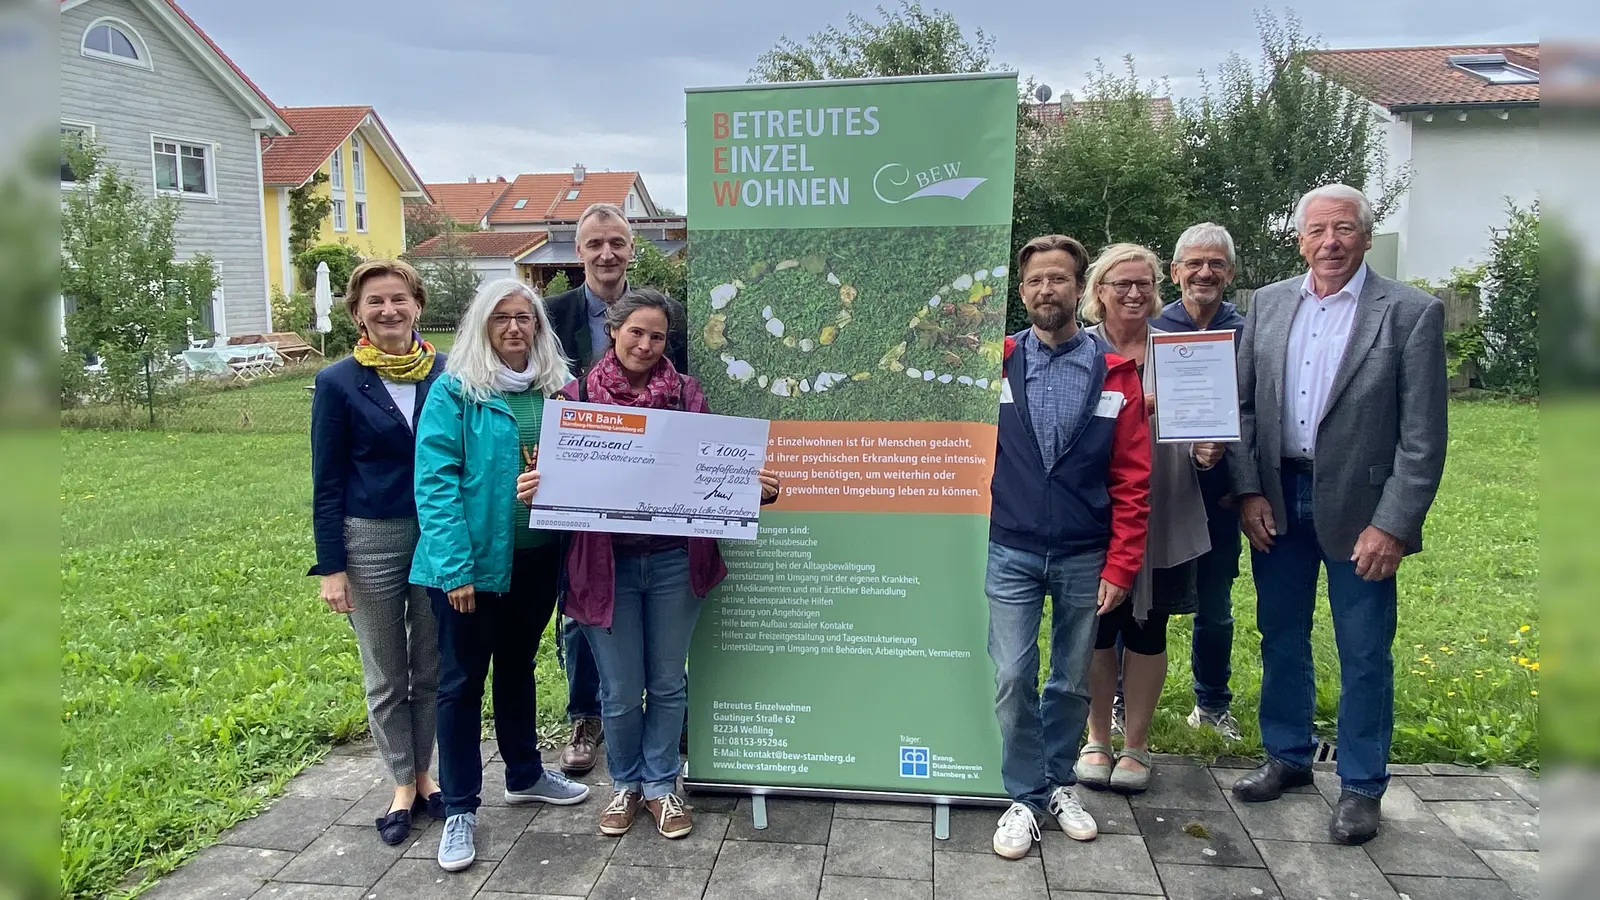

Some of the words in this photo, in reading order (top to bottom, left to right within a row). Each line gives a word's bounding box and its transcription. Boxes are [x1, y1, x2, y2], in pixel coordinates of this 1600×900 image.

[713, 106, 880, 139] BETREUTES
[713, 144, 815, 174] EINZEL
[915, 161, 962, 188] BEW
[713, 177, 849, 207] WOHNEN
[578, 412, 593, 422] VR
[596, 414, 624, 425] Bank
[558, 435, 632, 450] Eintausend
[777, 437, 843, 446] Einzelwohnen
[846, 437, 858, 447] ist
[861, 437, 875, 447] für
[878, 437, 926, 447] Menschen
[929, 437, 972, 449] gedacht,
[777, 453, 799, 462] ihrer
[802, 452, 859, 464] psychischen
[862, 453, 918, 465] Erkrankung
[921, 454, 942, 464] eine
[944, 454, 986, 465] intensive
[696, 474, 726, 485] August
[728, 474, 750, 485] 2023
[811, 468, 863, 480] benötigen,
[865, 471, 880, 479] um
[883, 470, 930, 480] weiterhin
[933, 470, 956, 480] oder
[786, 485, 840, 496] gewohnten
[843, 486, 895, 497] Umgebung
[898, 486, 925, 496] leben
[928, 487, 939, 496] zu
[942, 486, 981, 497] können.
[718, 506, 756, 518] Starnberg
[790, 526, 810, 535] sind:
[769, 538, 818, 547] Hausbesuche
[721, 549, 755, 557] intensive
[757, 549, 812, 559] Einzelberatung
[776, 561, 787, 569] bei
[789, 561, 801, 569] der
[803, 562, 875, 573] Alltagsbewältigung
[726, 572, 774, 582] nterstützung
[787, 573, 818, 583] Umgang
[821, 574, 833, 582] mit
[835, 574, 848, 582] der
[849, 575, 880, 584] eigenen
[881, 575, 920, 585] Krankheit,
[736, 584, 791, 593] Medikamenten
[793, 585, 808, 593] und
[824, 586, 859, 594] ärztlicher
[861, 587, 906, 597] Behandlung
[721, 596, 746, 605] aktive,
[747, 596, 809, 606] lebenspraktische
[811, 597, 833, 606] Hilfen
[721, 607, 755, 618] Beratung
[772, 608, 820, 619] Angehörigen
[721, 619, 739, 628] Hilfe
[740, 619, 759, 628] beim
[760, 620, 787, 628] Aufbau
[789, 620, 818, 629] sozialer
[820, 621, 854, 630] Kontakte
[721, 631, 743, 639] Hilfen
[745, 632, 757, 640] zur
[759, 632, 825, 643] Freizeitgestaltung
[827, 633, 840, 642] und
[842, 633, 918, 646] Tagesstrukturierung
[721, 643, 774, 654] Unterstützung
[776, 644, 785, 652] im
[787, 644, 819, 655] Umgang
[821, 645, 834, 653] mit
[835, 645, 874, 655] Behörden,
[875, 646, 927, 658] Arbeitgebern,
[928, 648, 971, 658] Vermietern
[713, 701, 752, 710] Betreutes
[754, 702, 811, 713] Einzelwohnen
[713, 713, 753, 723] Gautinger
[756, 714, 782, 723] Straße
[785, 715, 796, 724] 62
[713, 725, 738, 734] 82234
[740, 725, 774, 736] Weßling
[728, 737, 788, 748] 08153-952946
[900, 734, 922, 745] Träger:
[713, 748, 741, 758] E-Mail:
[743, 749, 856, 764] kontakt@bew-starnberg.de
[713, 761, 809, 774] www.bew-starnberg.de
[932, 763, 982, 771] Diakonieverein
[932, 771, 966, 780] Starnberg
